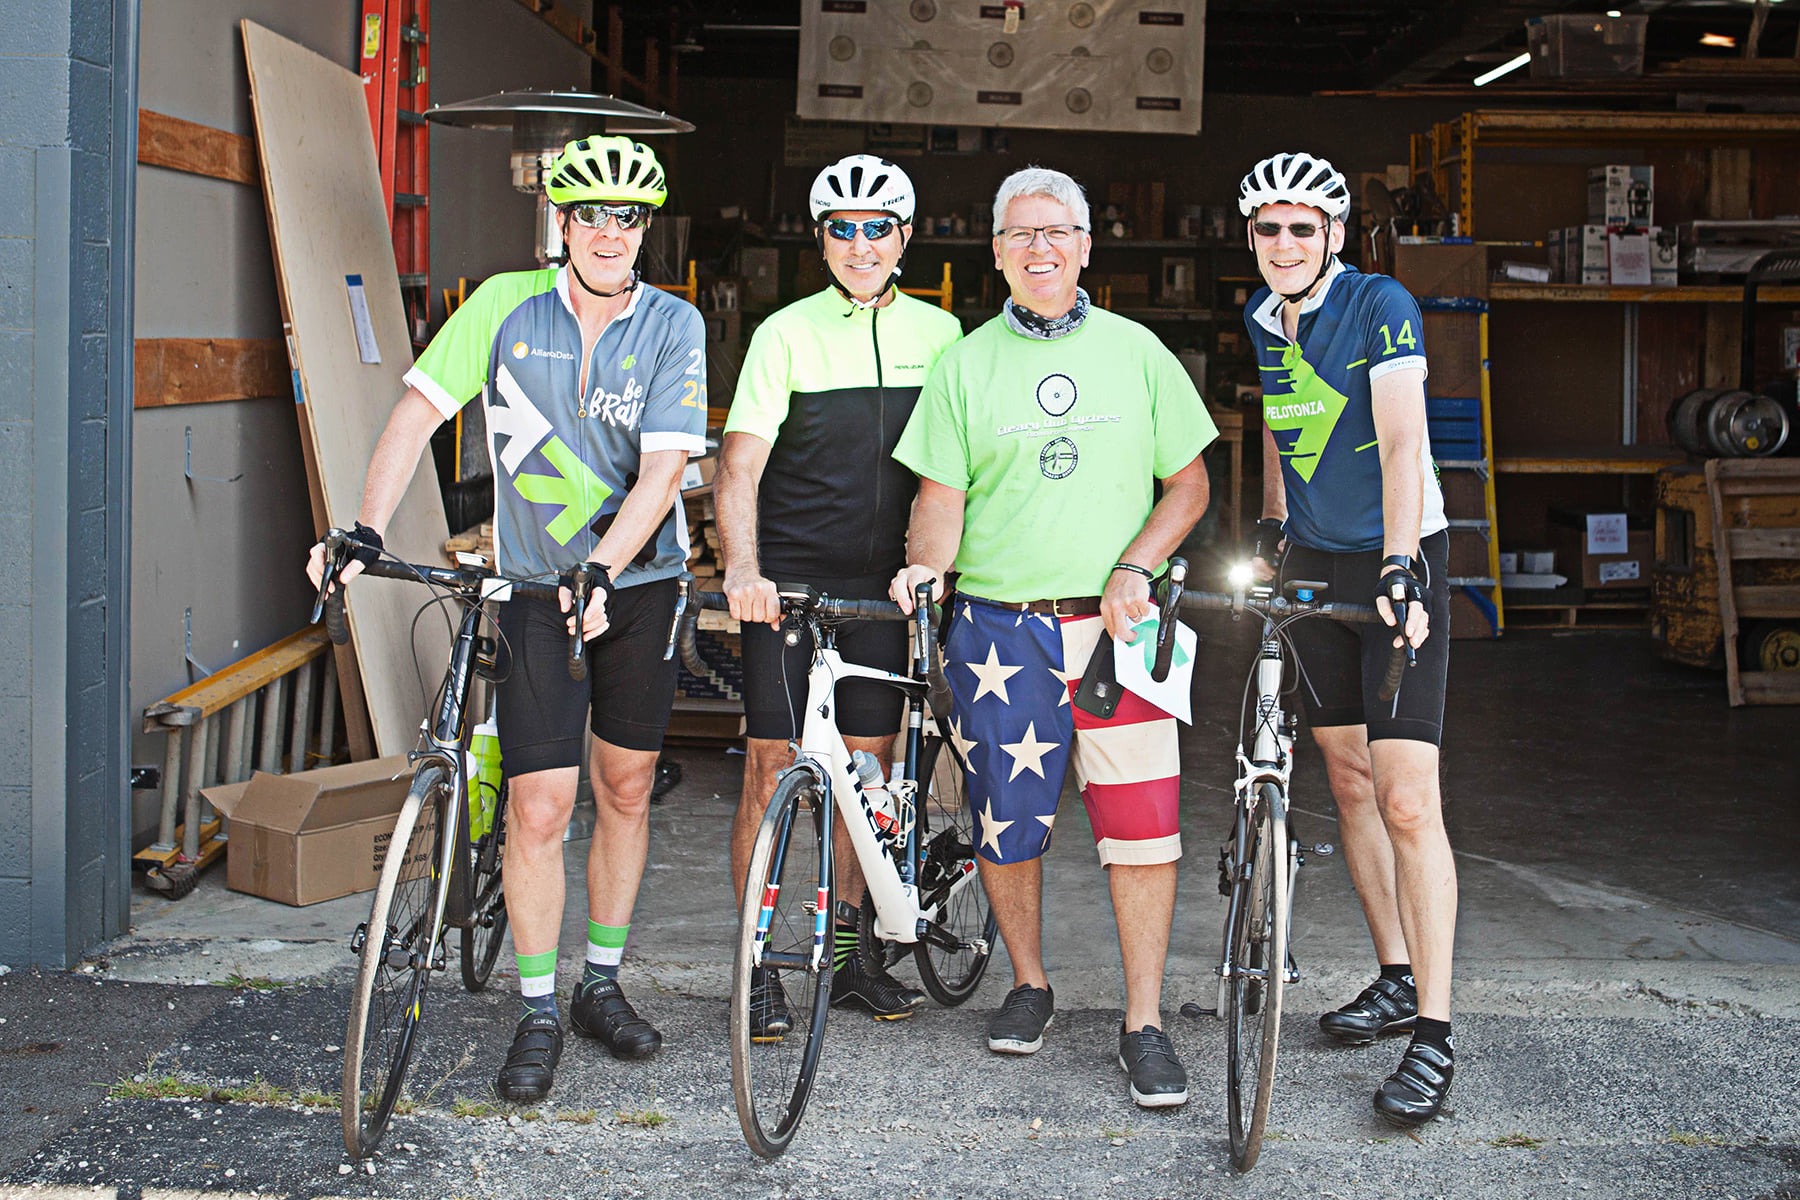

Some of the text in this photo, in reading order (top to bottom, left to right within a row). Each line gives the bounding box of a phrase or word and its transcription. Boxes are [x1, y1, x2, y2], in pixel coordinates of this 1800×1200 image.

[1378, 319, 1417, 356] 14
[622, 377, 643, 402] Be
[1265, 400, 1326, 420] PELOTONIA
